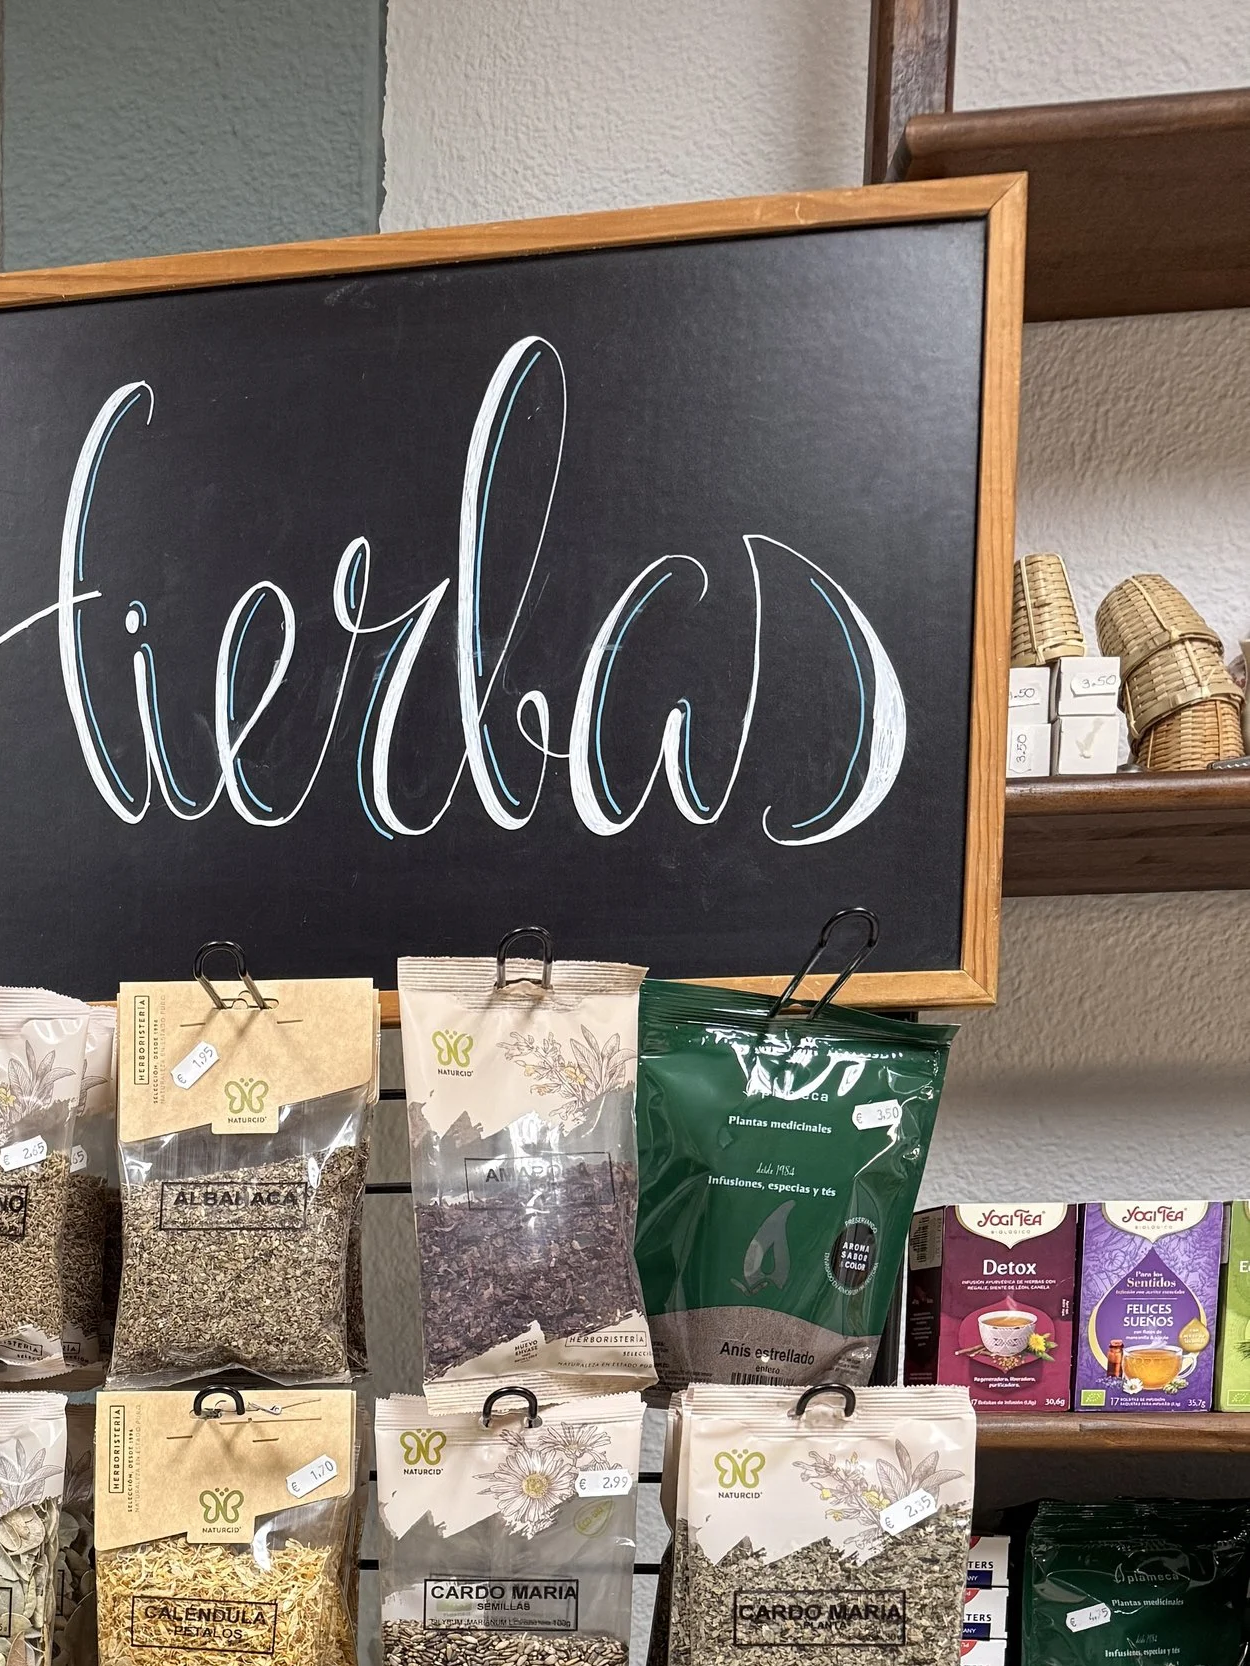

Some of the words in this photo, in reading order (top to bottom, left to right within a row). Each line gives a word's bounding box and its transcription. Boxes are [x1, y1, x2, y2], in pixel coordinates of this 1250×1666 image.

[1082, 675, 1116, 688] 3.50
[138, 1000, 146, 1081] HERBORISTERÍA
[728, 1115, 767, 1128] Plantas
[770, 1120, 832, 1134] medicinales
[708, 1174, 763, 1193] Infusiones,
[768, 1180, 808, 1194] especias
[822, 1186, 836, 1197] tés
[1122, 1205, 1157, 1223] YOGI
[983, 1260, 1037, 1275] Detox
[1127, 1277, 1176, 1288] Sentidos
[1126, 1304, 1171, 1314] FELICES
[1123, 1314, 1173, 1327] SUEÑOS
[720, 1341, 751, 1359] Anís
[755, 1344, 814, 1366] estrellado
[1045, 1398, 1065, 1407] 30,6g
[1188, 1398, 1205, 1408] 35,7g
[579, 1478, 586, 1490] €
[431, 1585, 505, 1600] CARDO
[511, 1583, 578, 1600] MARIA
[144, 1605, 267, 1625] CALÉNDULA
[738, 1604, 821, 1624] CARDO
[828, 1601, 902, 1622] MARIA
